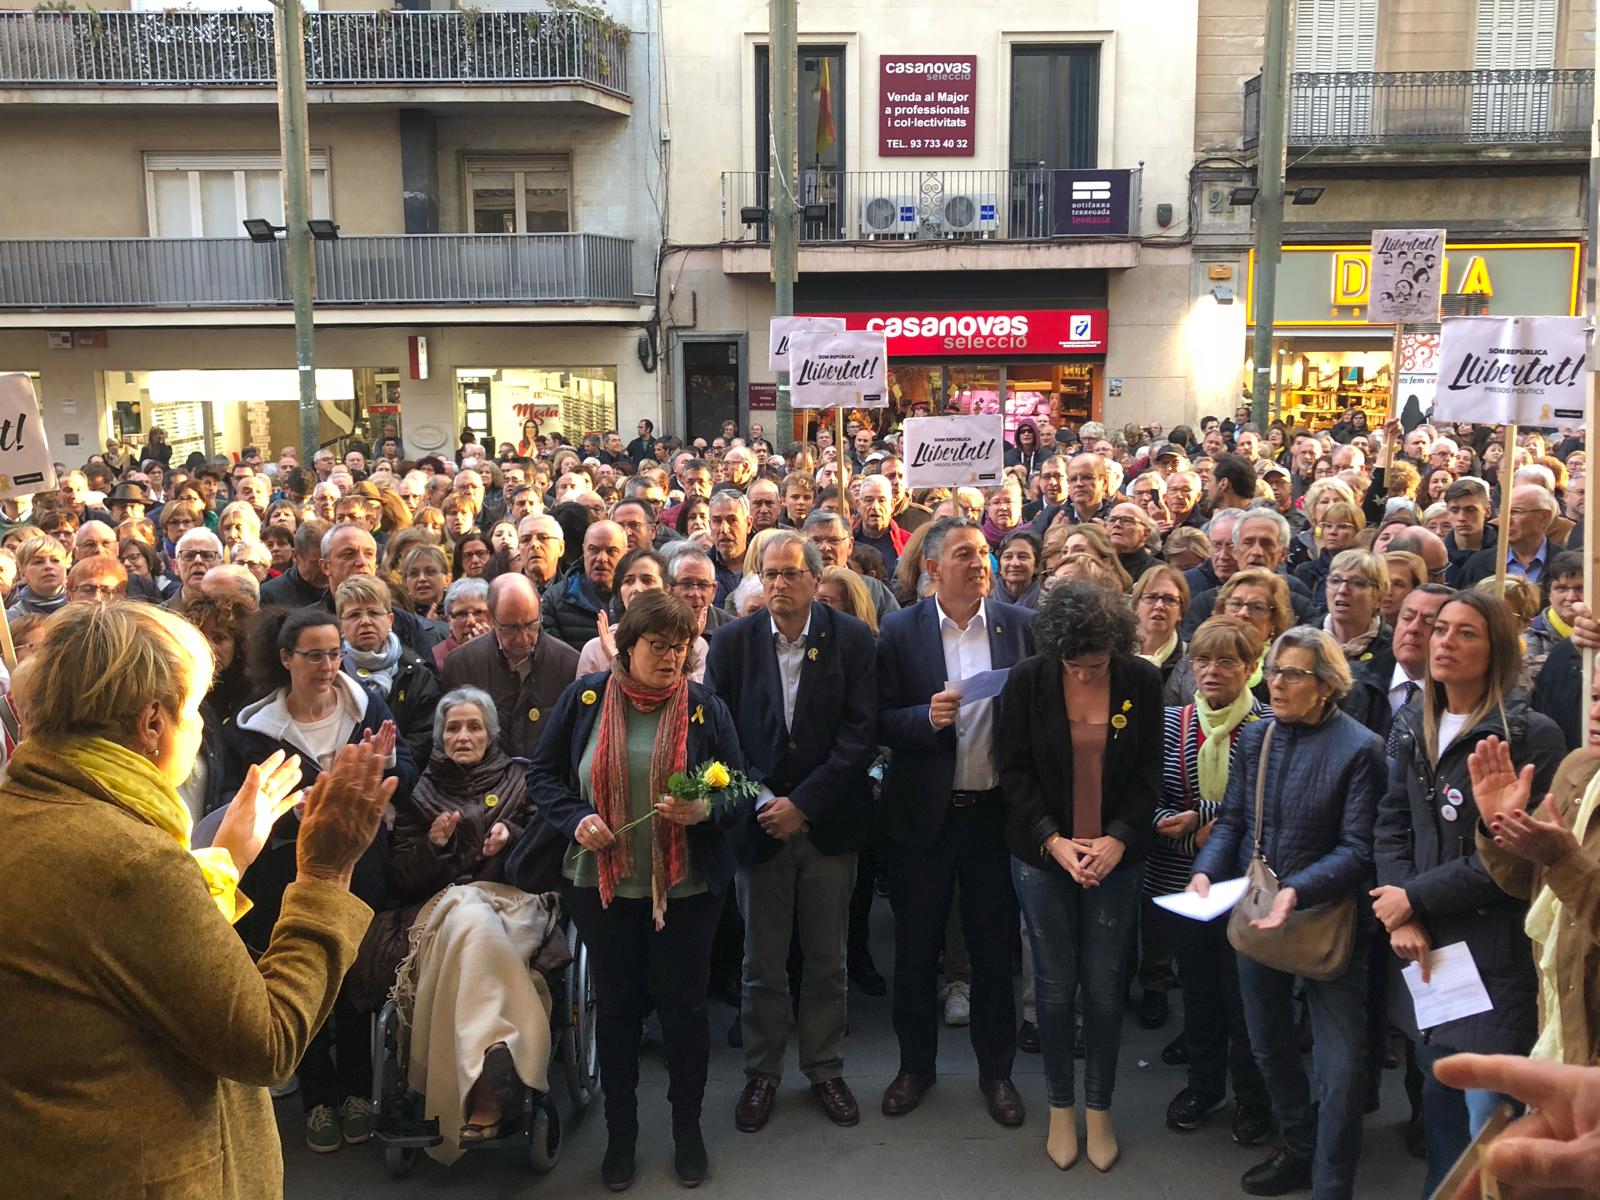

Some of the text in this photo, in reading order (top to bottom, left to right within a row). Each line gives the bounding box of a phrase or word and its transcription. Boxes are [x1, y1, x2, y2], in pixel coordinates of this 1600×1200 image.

[885, 62, 971, 74] casanovas
[887, 92, 969, 104] Venda al Major
[884, 105, 970, 117] a professionals
[887, 117, 891, 127] i
[886, 139, 968, 148] TEL. 93 733 40 32
[866, 315, 1028, 338] casanovas
[1488, 347, 1505, 355] SOM
[796, 356, 879, 386] Llibertat!
[1447, 352, 1586, 391] Llibertat!
[1484, 386, 1511, 394] PRESOS
[910, 438, 996, 468] Llibertat!
